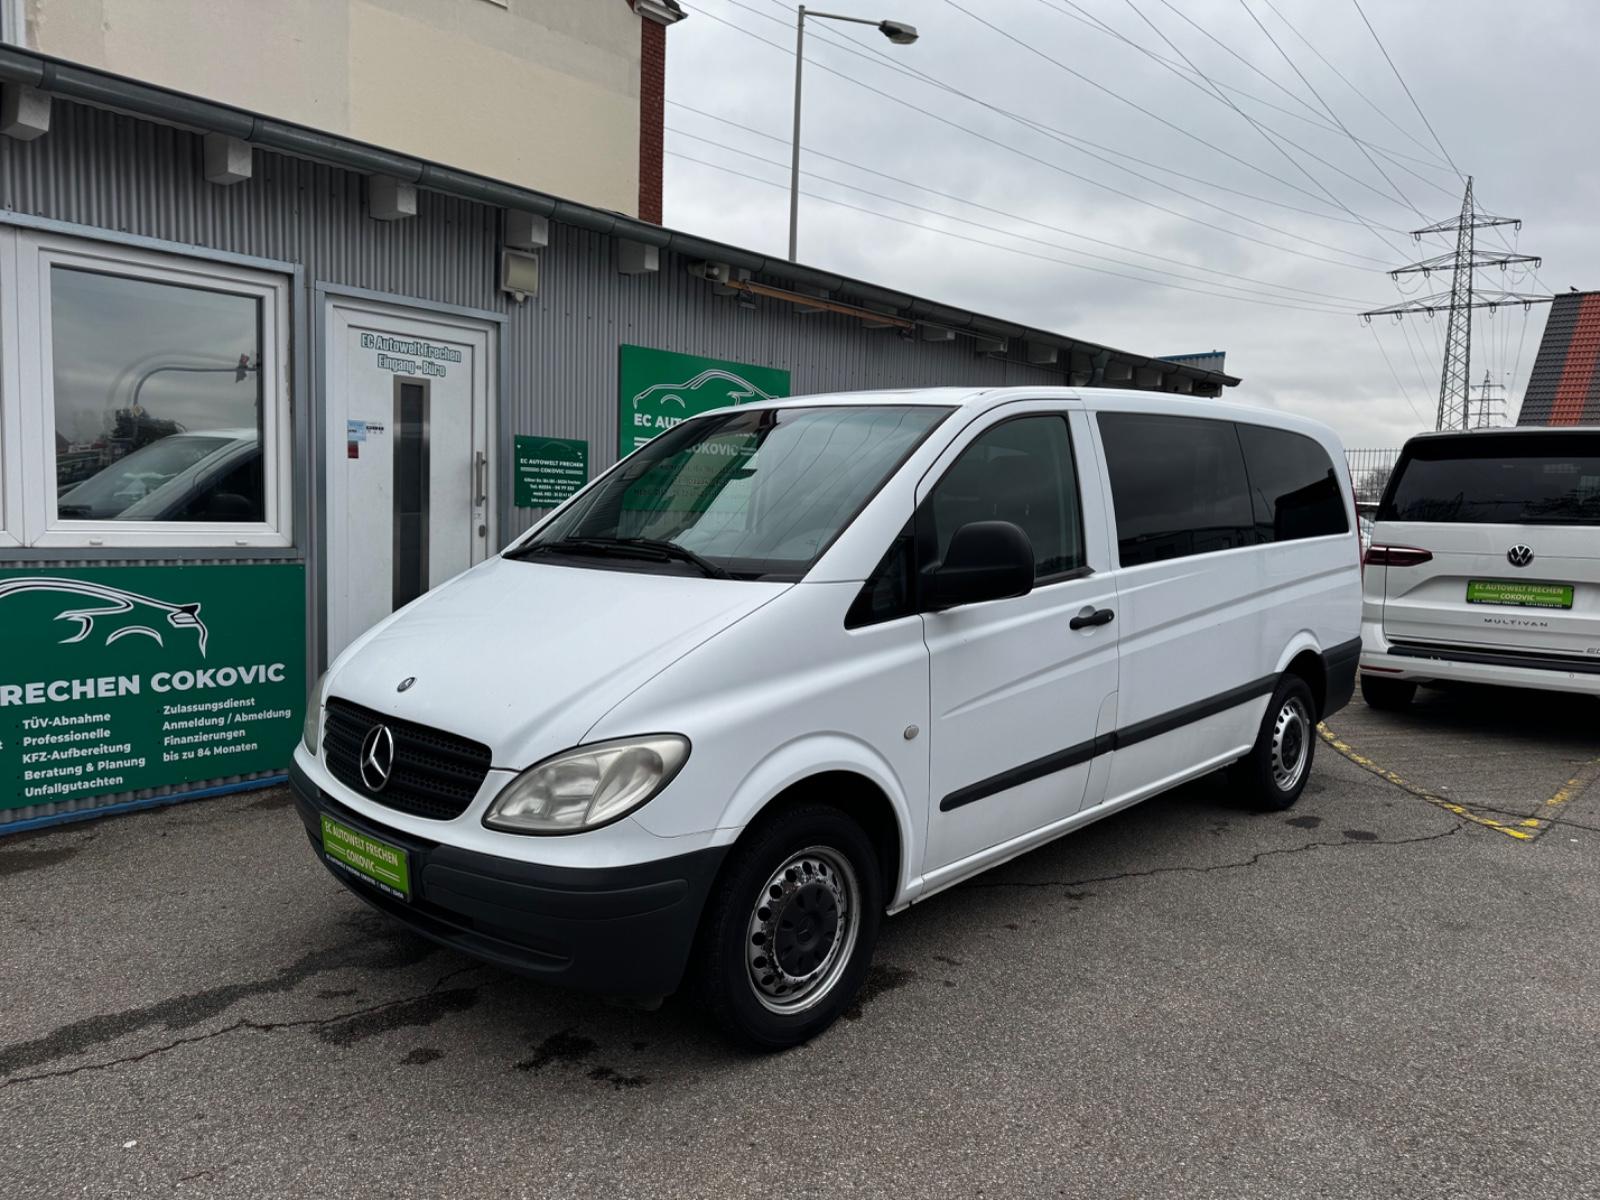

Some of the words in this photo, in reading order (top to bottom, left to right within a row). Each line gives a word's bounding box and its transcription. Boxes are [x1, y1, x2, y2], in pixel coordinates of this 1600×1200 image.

[361, 333, 374, 349] EC
[375, 335, 422, 355] Autowelt
[423, 343, 461, 363] Frechen
[377, 353, 415, 374] Eingang
[422, 360, 446, 377] Büro
[634, 413, 651, 427] EC
[655, 415, 683, 428] AUT
[686, 443, 740, 456] OKOVIC
[1486, 584, 1526, 592] AUTOWELT
[1527, 586, 1563, 594] FRECHEN
[1500, 593, 1536, 601] COKOVIC
[1484, 618, 1548, 627] MULTIVAN
[0, 674, 140, 706] RECHEN
[150, 662, 286, 693] COKOVIC
[163, 697, 255, 715] Zulassungsdienst
[22, 713, 111, 730] TÜV-Abnahme
[162, 716, 224, 731] Anmeldung
[234, 709, 291, 723] Abmeldung
[23, 728, 111, 746] Professionelle
[164, 729, 246, 746] Finanzierungen
[22, 743, 131, 764] KFZ-Aufbereitung
[163, 751, 179, 762] bis
[182, 750, 195, 759] zu
[197, 748, 211, 758] 84
[214, 742, 258, 755] Monaten
[24, 765, 82, 780] Beratung
[86, 763, 94, 773] &
[97, 757, 146, 771] Planung
[25, 776, 123, 797] Unfallgutachten
[324, 821, 333, 833] EC
[333, 826, 364, 851] AUTOWELT
[366, 841, 398, 866] FRECHEN
[346, 849, 375, 873] COKOVIC
